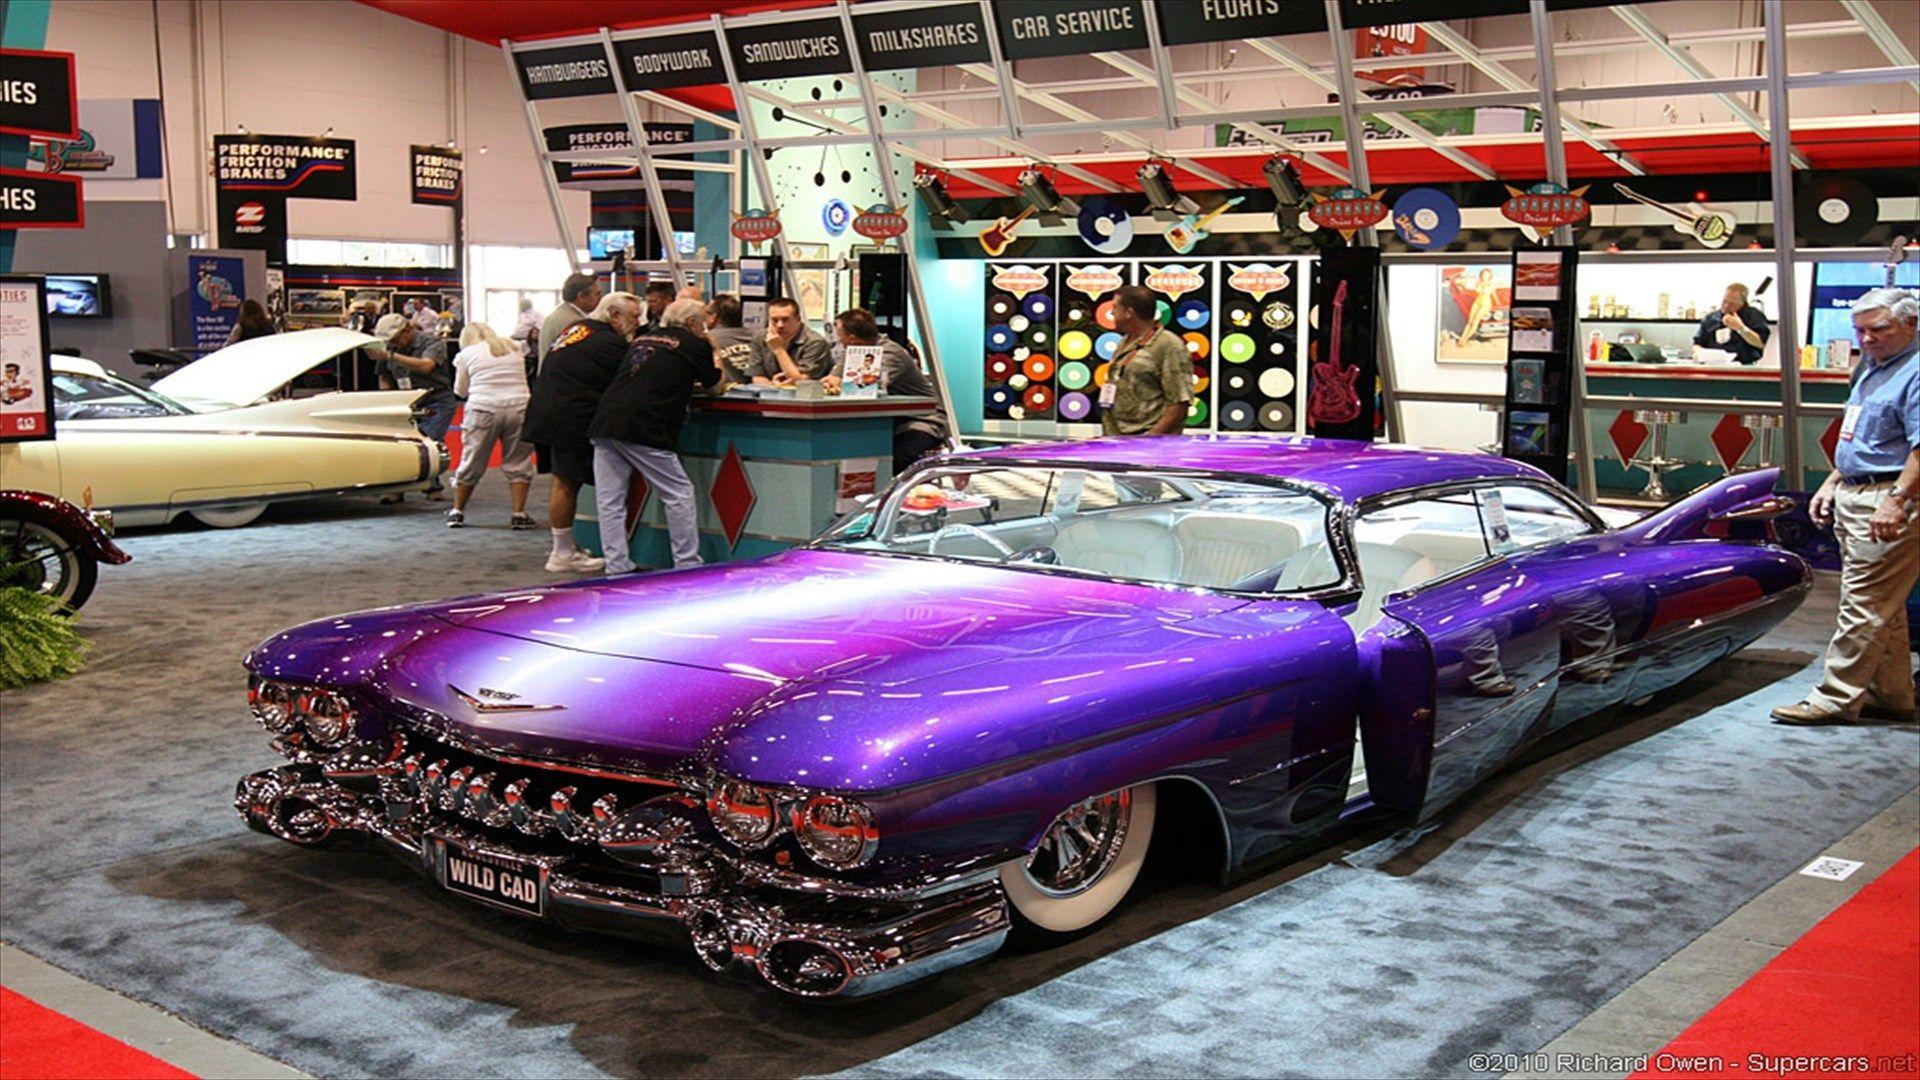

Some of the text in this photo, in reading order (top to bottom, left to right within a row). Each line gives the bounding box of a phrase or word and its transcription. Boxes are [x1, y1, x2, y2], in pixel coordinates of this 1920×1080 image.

[1203, 0, 1279, 20] FLOATS
[1012, 7, 1134, 39] CAR SERVICE
[869, 23, 979, 52] MILKSHAKES
[743, 36, 840, 63] SANDWICHES
[633, 49, 712, 73] BODYWORK
[526, 59, 609, 84] HAMBURGERS
[569, 130, 685, 144] PERFORANCE
[218, 144, 345, 160] PERFORMANCE
[219, 156, 297, 169] FRICTION
[219, 168, 287, 179] BRAKES
[416, 165, 459, 180] FRICTION
[416, 177, 456, 190] BRAKES
[0, 290, 28, 301] TIES
[449, 857, 537, 904] WILD CAD
